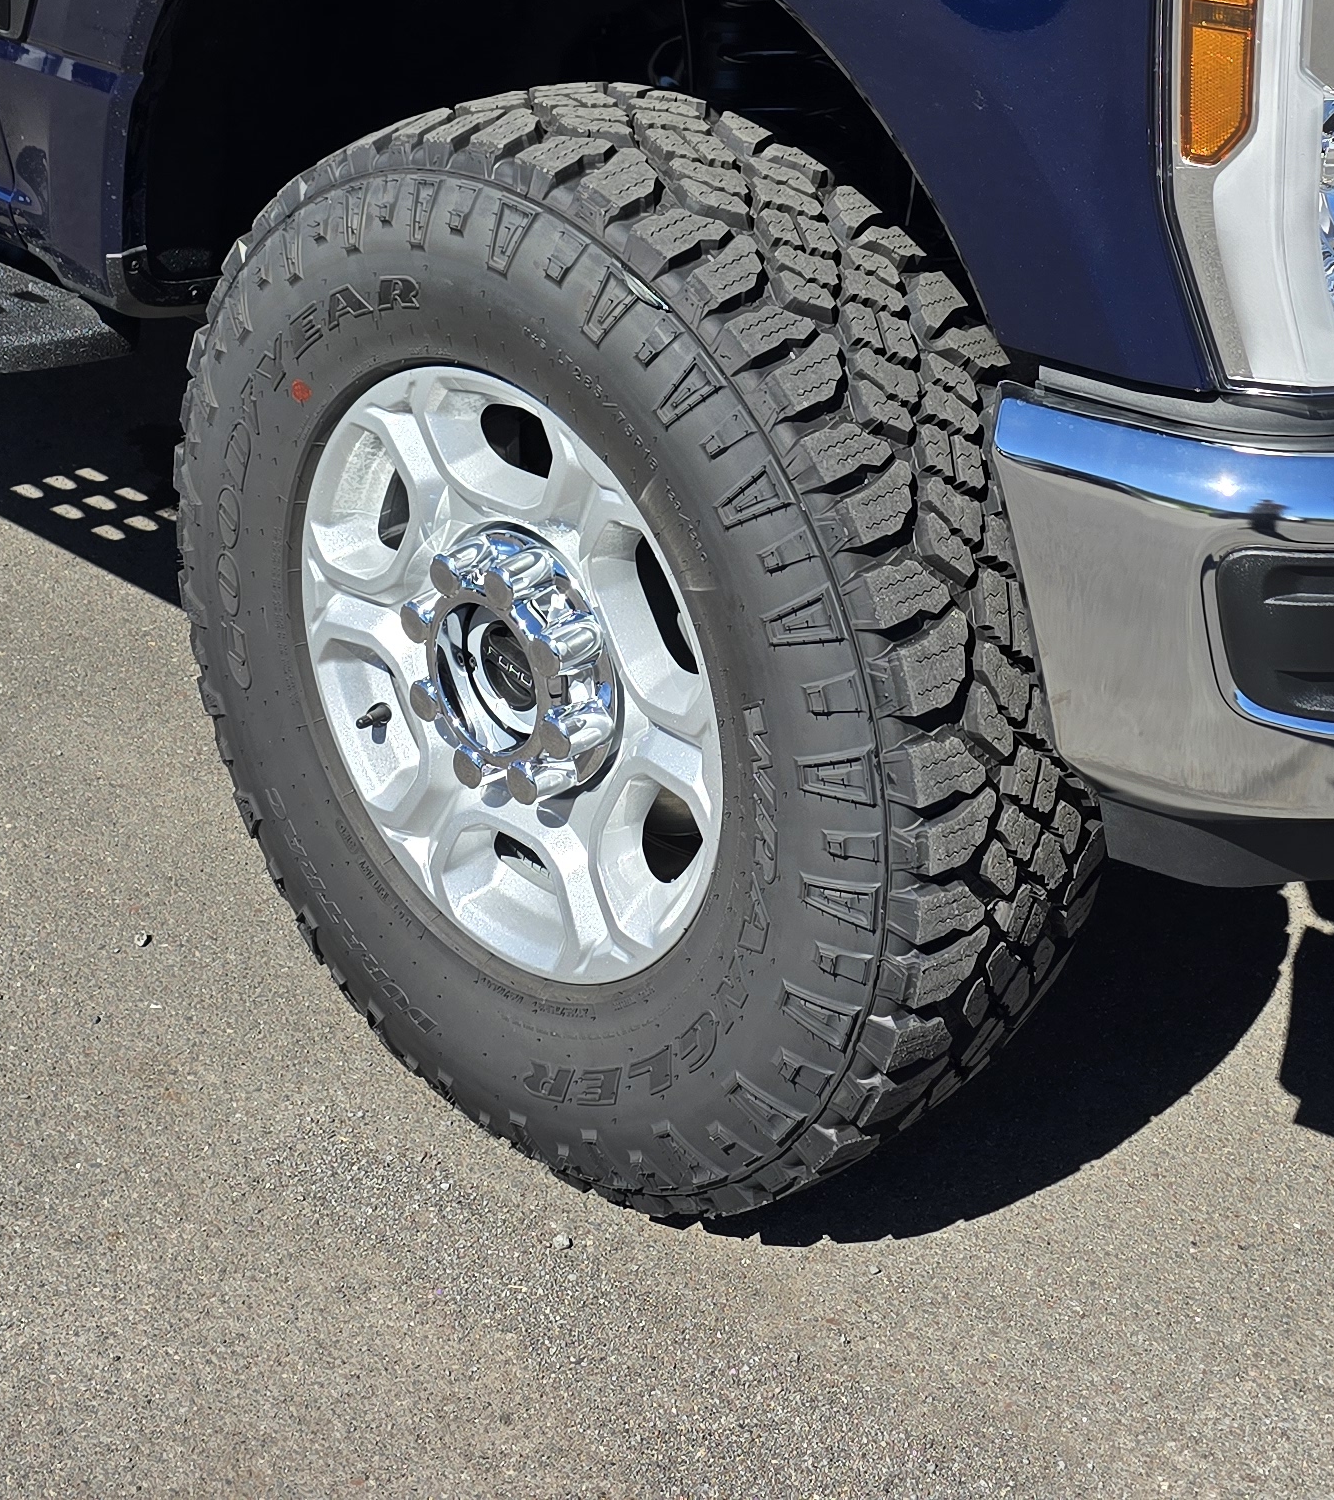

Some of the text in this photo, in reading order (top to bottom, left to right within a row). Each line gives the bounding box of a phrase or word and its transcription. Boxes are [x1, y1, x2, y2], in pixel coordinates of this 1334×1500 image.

[215, 274, 421, 690] GOODYEAR
[265, 787, 438, 1034] DURATRAC
[522, 701, 779, 1107] WRANGLER
